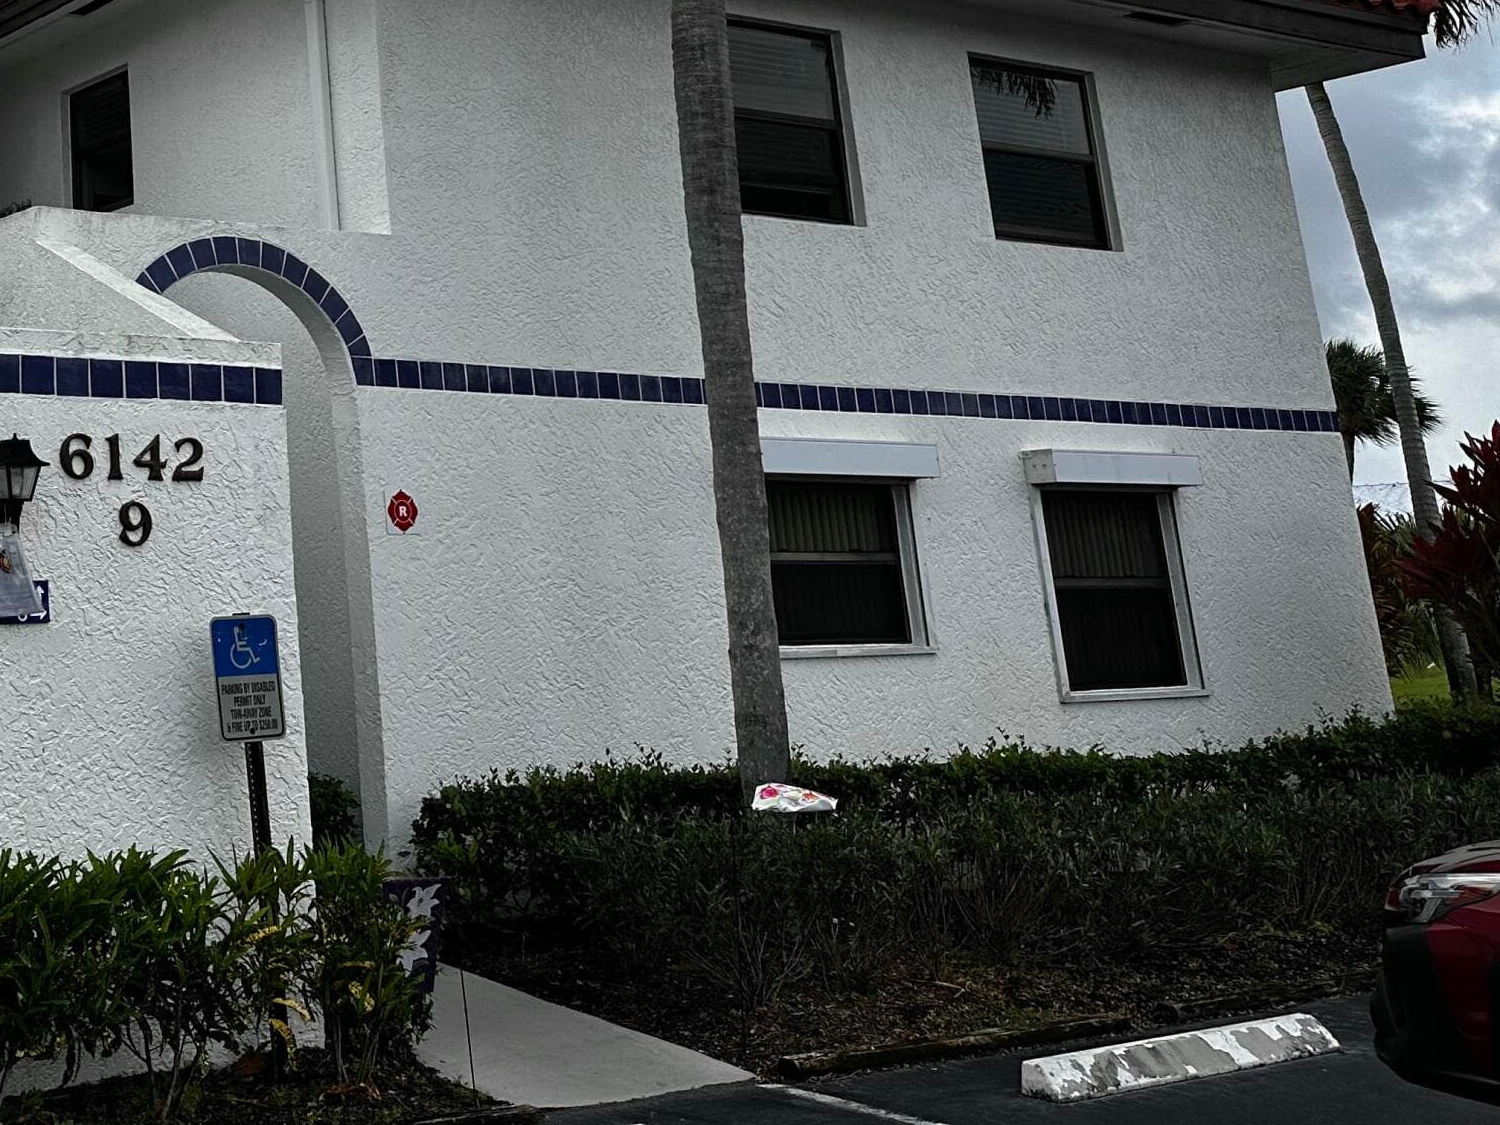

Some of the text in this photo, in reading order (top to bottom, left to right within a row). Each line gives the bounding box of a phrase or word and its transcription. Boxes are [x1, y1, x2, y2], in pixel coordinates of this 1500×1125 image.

[59, 432, 205, 482] 6142
[398, 505, 408, 517] R
[118, 500, 153, 547] 9
[221, 681, 276, 695] PARKING BY DISABLED
[234, 694, 266, 707] PERMIT ONLY
[230, 706, 272, 720] TOW-AWAY ZONE
[232, 721, 244, 733] FINE
[244, 720, 251, 732] UP
